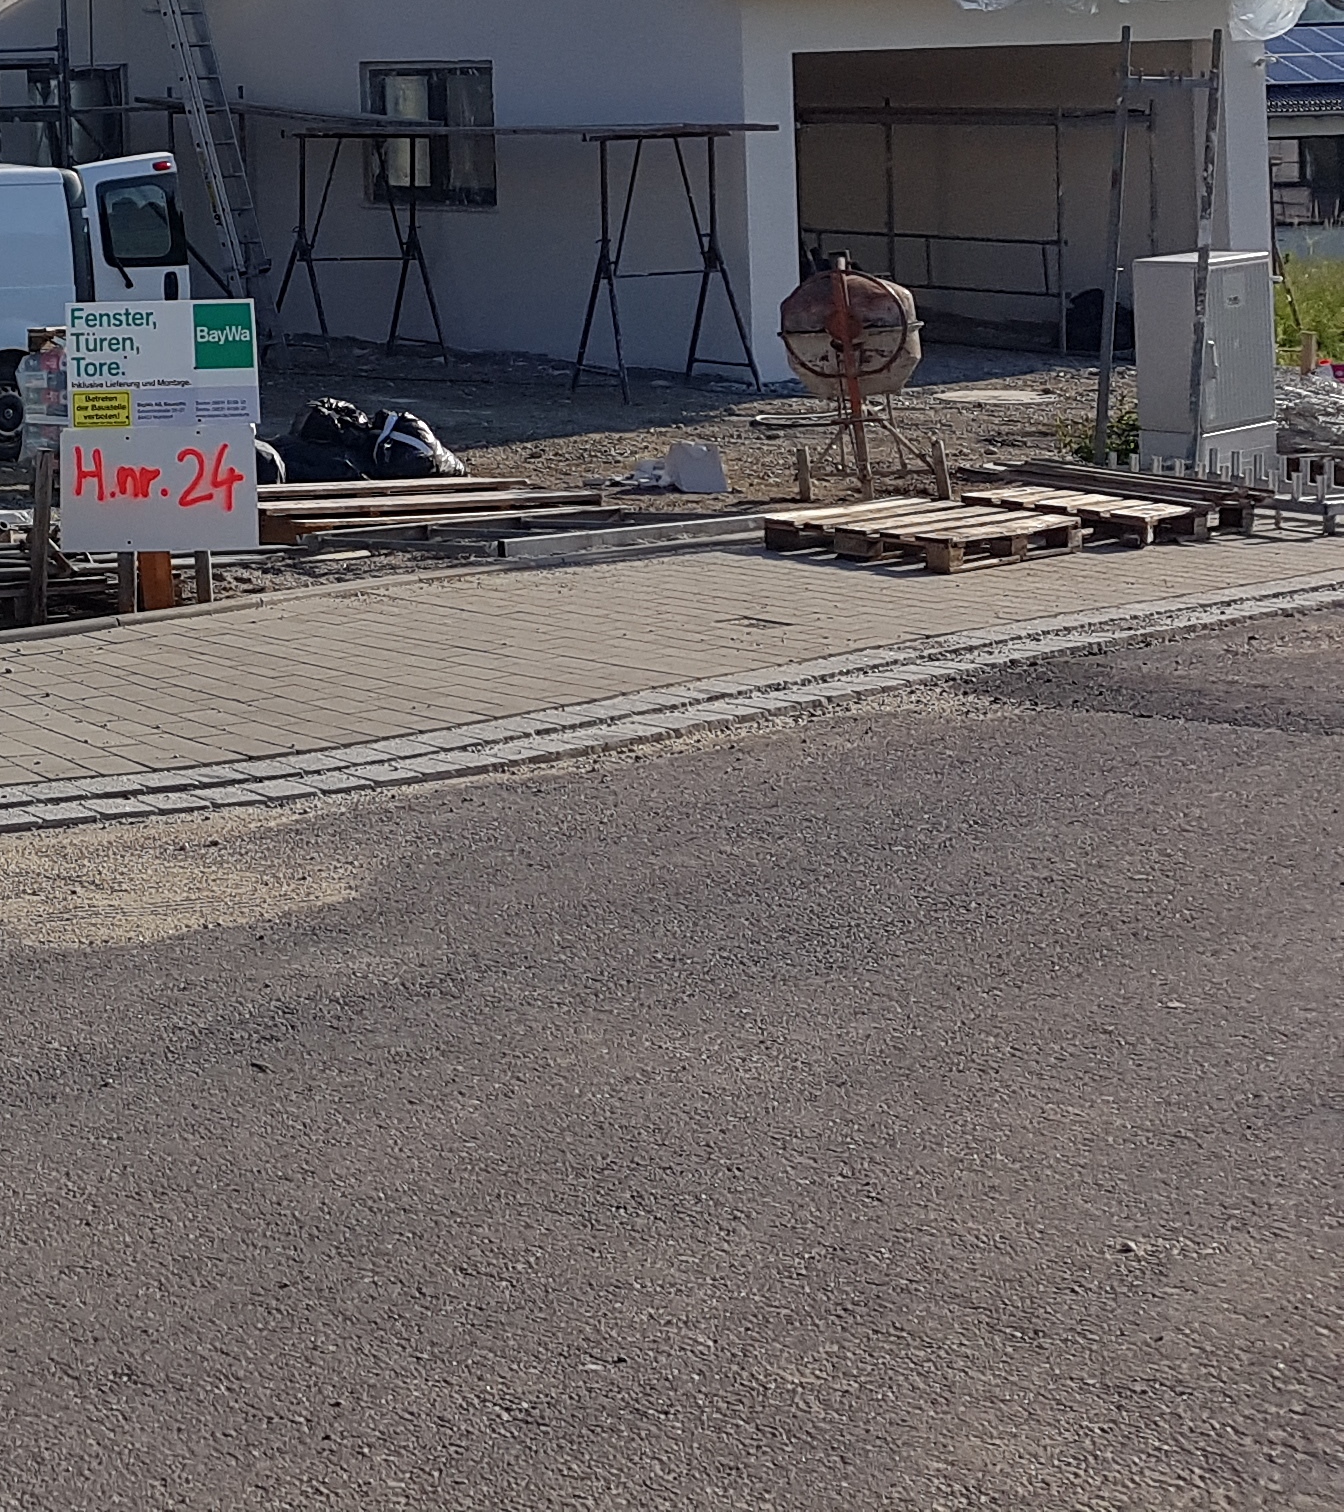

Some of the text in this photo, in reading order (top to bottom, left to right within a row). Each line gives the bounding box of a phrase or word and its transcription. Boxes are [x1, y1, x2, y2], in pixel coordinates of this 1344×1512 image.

[70, 307, 157, 330] Fenster,
[70, 332, 140, 355] Türen,
[196, 326, 250, 345] BayWa
[70, 356, 126, 377] Tore.
[105, 380, 140, 388] Lieferung
[142, 379, 155, 387] und
[177, 443, 244, 512] 24
